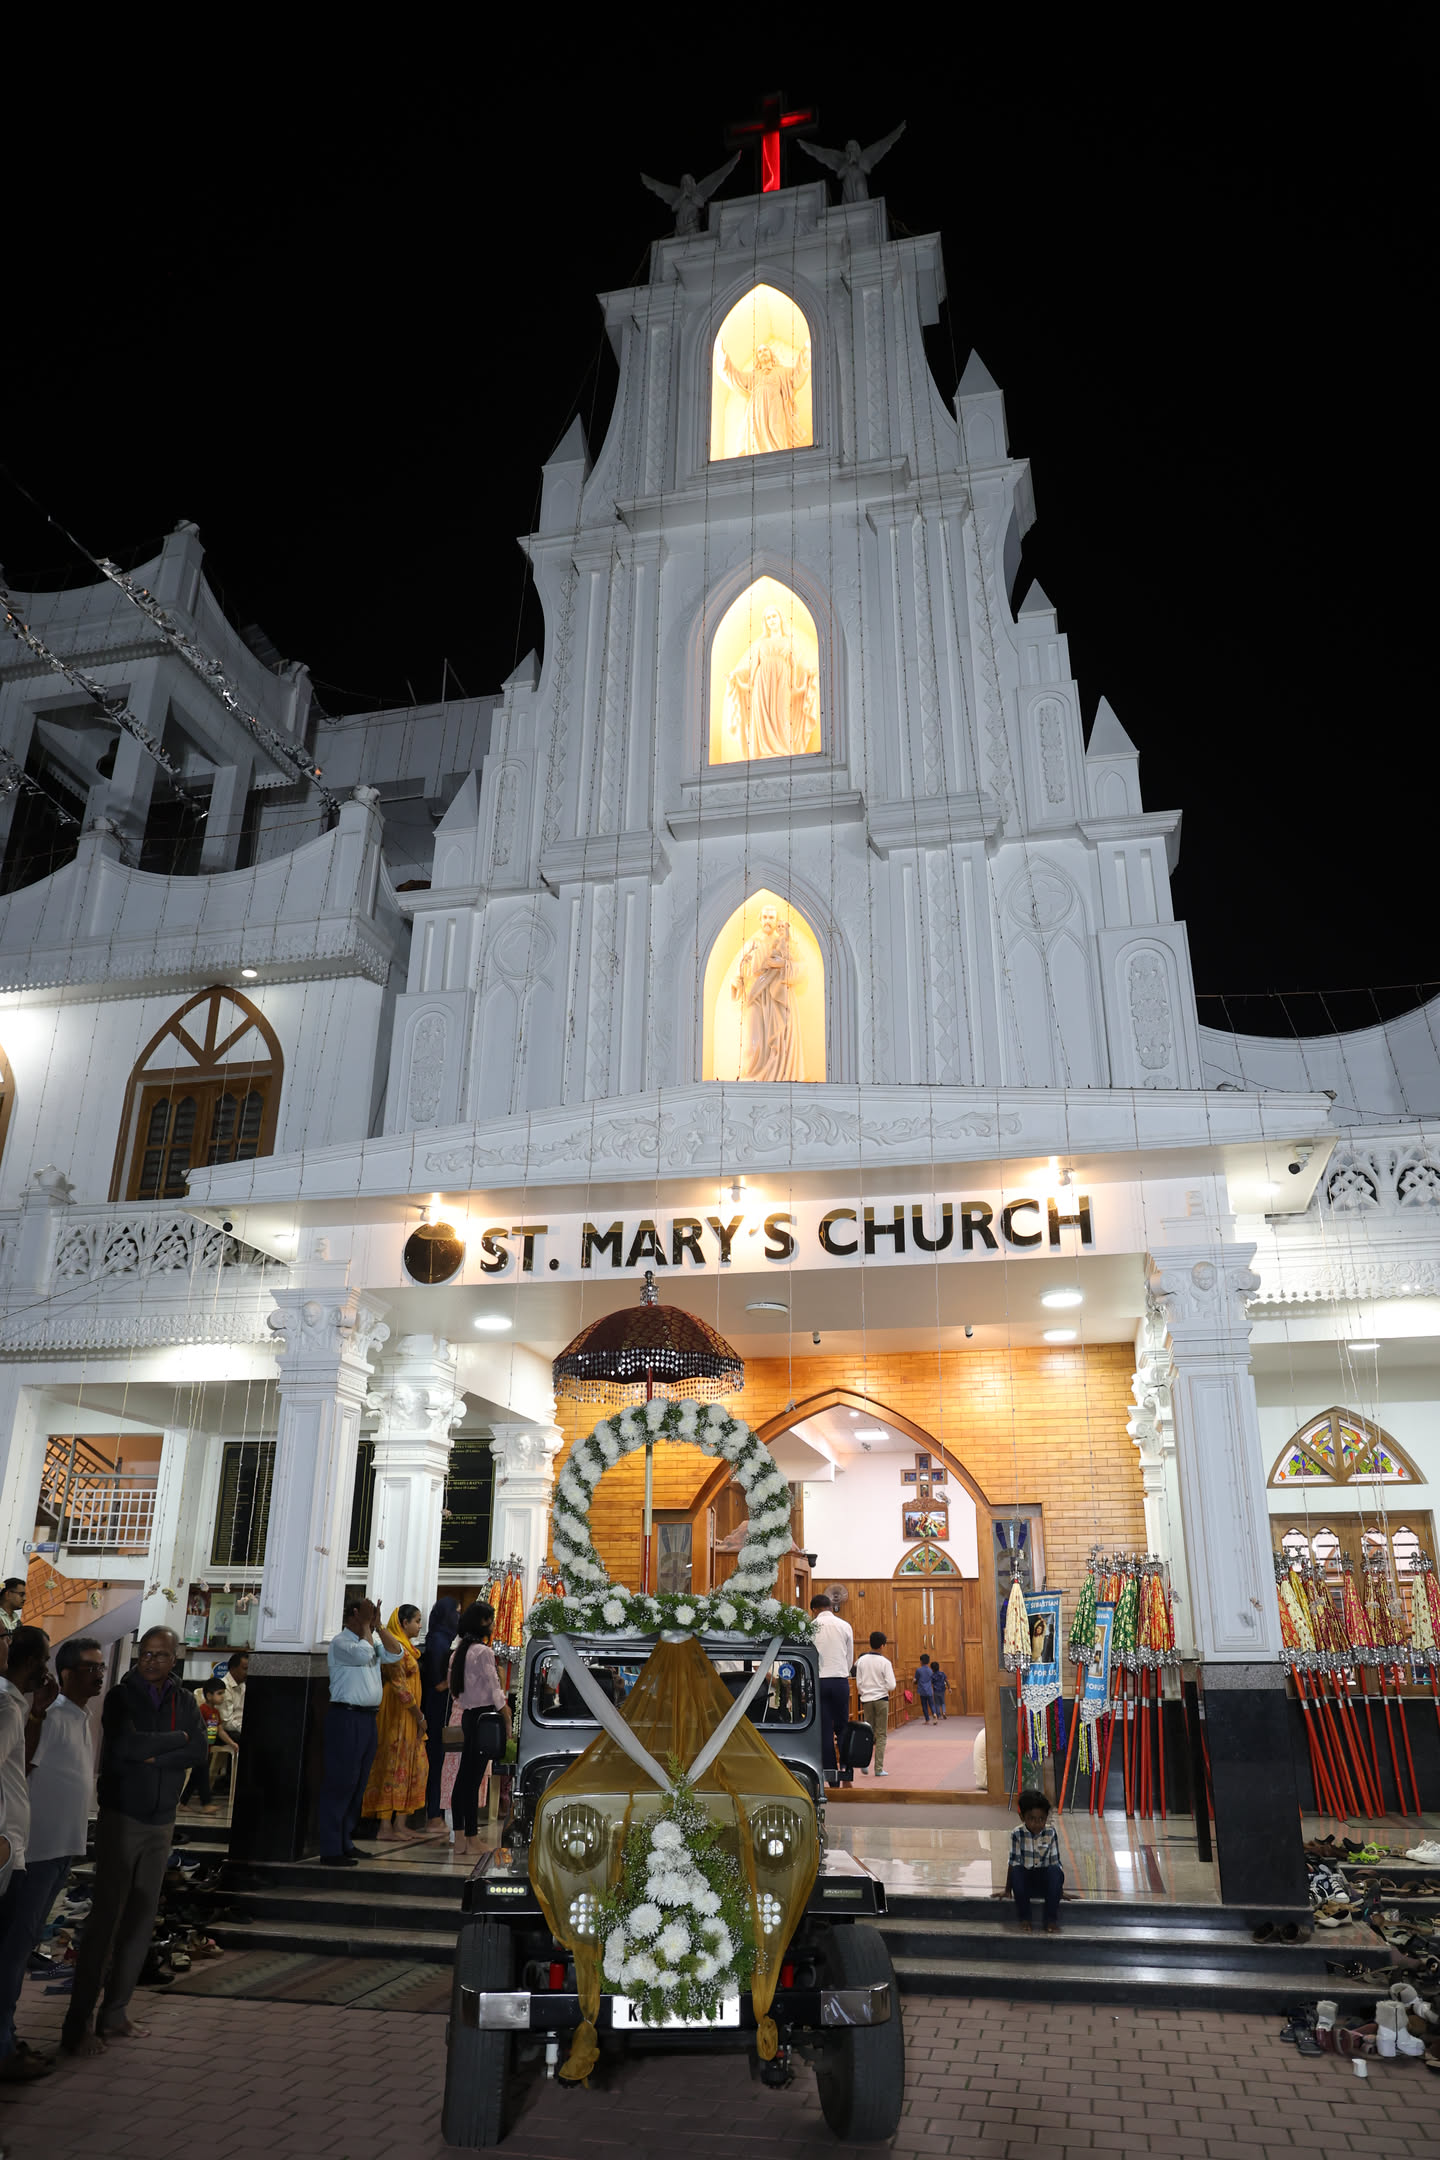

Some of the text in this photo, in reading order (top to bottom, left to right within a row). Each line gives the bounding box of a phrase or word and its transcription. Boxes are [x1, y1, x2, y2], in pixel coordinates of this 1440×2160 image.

[480, 1195, 1092, 1272] ST. MARY'S CHURCH
